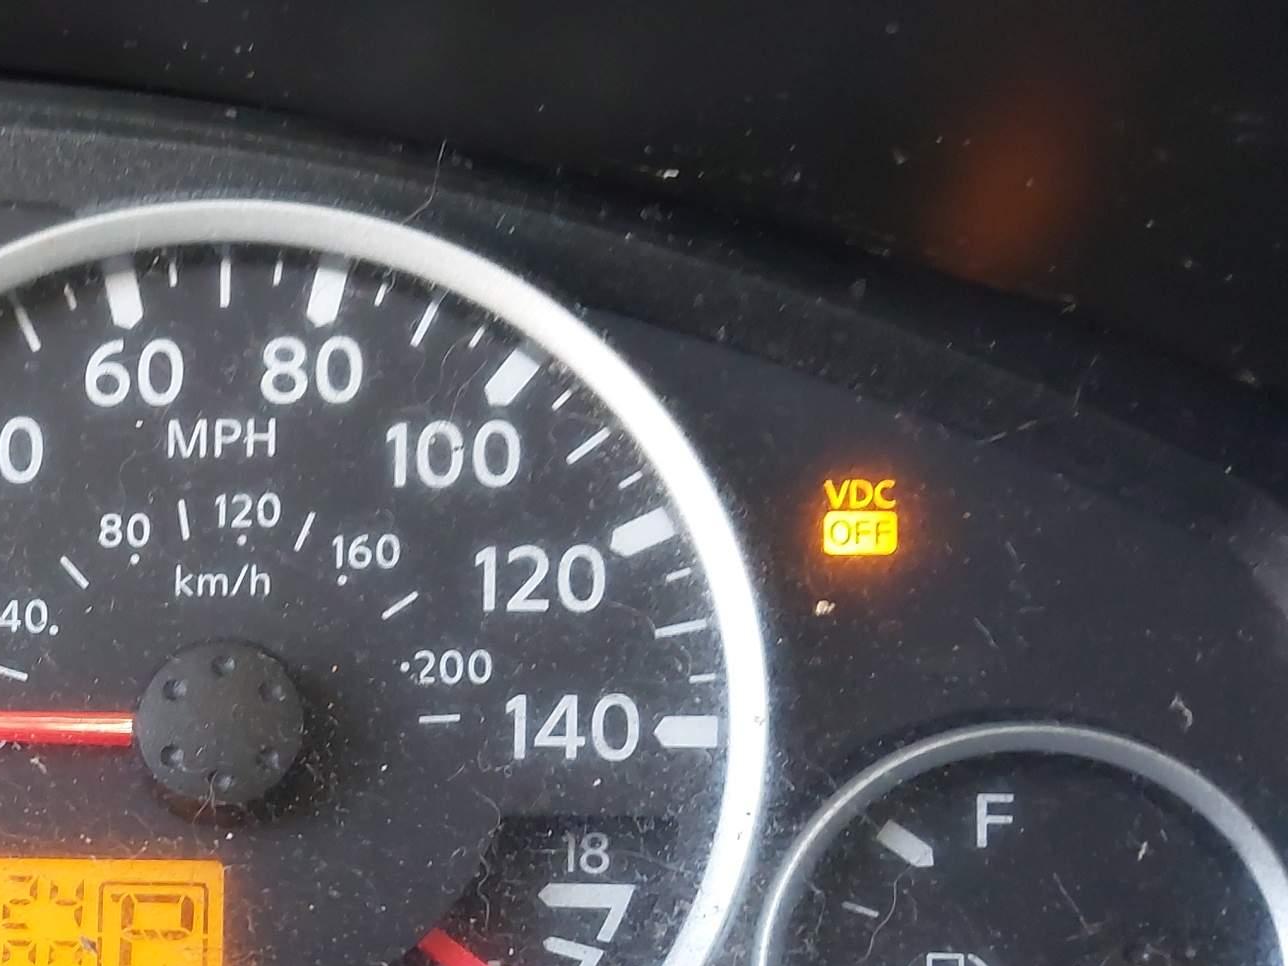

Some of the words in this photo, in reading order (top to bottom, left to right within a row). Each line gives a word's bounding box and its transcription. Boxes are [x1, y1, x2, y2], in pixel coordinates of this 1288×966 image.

[85, 338, 185, 407] 60
[260, 335, 364, 405] 80
[166, 417, 278, 459] MPH
[385, 420, 522, 488] 100
[214, 493, 282, 529] 120
[823, 479, 897, 510] VDC
[97, 513, 151, 548] 80
[333, 533, 401, 569] 160
[829, 519, 893, 547] OFF
[174, 565, 271, 598] km/h
[475, 544, 606, 613] 120
[413, 649, 493, 685] 200
[505, 693, 640, 762] 140
[976, 793, 1014, 849] F
[564, 832, 610, 874] 18
